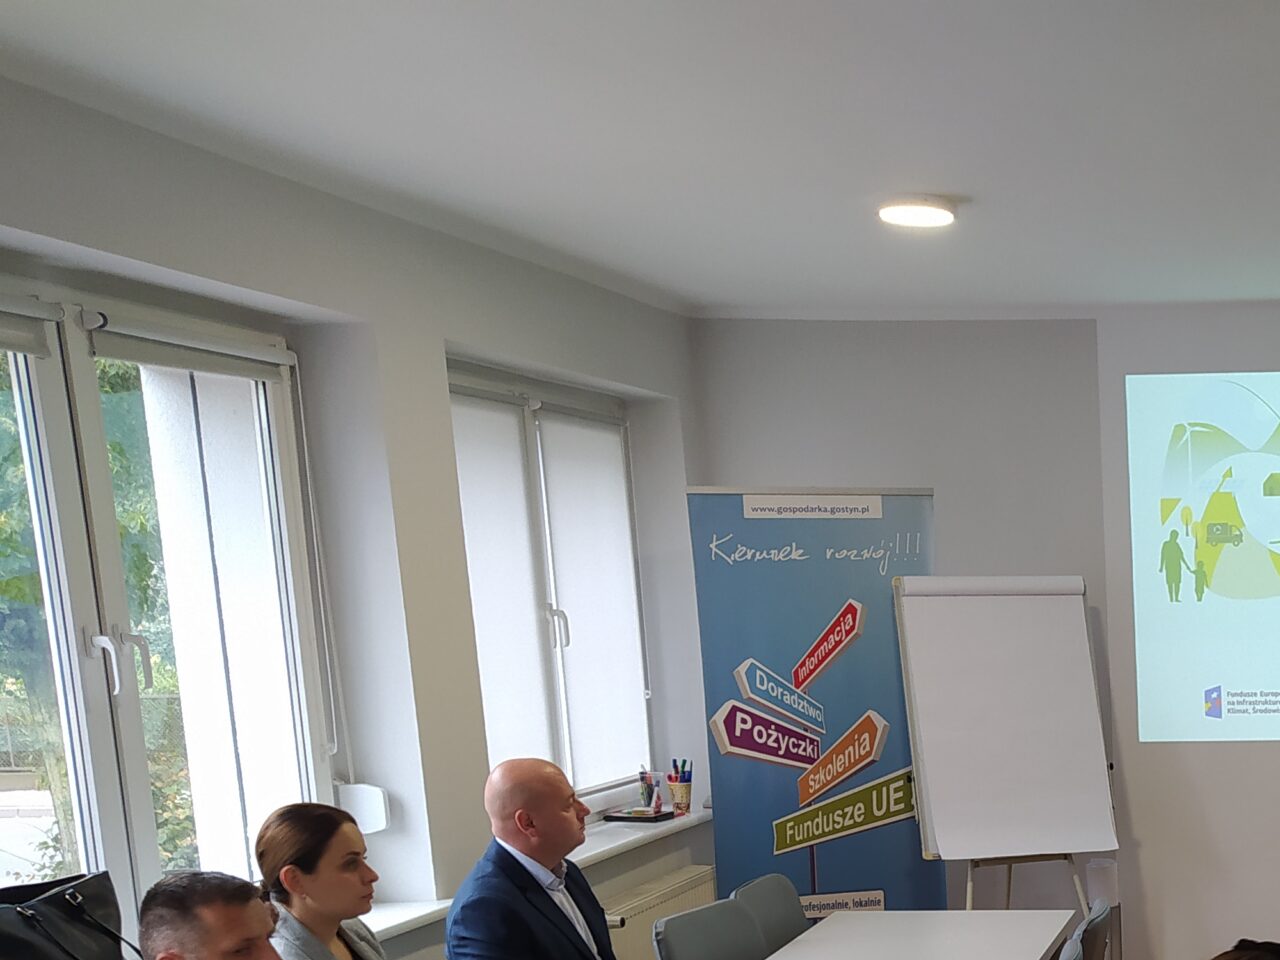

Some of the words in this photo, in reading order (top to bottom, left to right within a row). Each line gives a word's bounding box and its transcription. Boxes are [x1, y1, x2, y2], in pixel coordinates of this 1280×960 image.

[751, 505, 870, 516] www.gospodarka.gostyn.pl
[709, 533, 810, 565] Kierunek
[798, 612, 854, 682] Informacja
[755, 668, 823, 723] Doradztwo
[734, 711, 819, 759] Pożyczki
[808, 730, 871, 794] Szkolenia
[786, 801, 865, 844] Fundusze
[872, 779, 905, 817] UE
[800, 899, 851, 914] rofesjonalnie,
[852, 896, 882, 909] lokalnie
